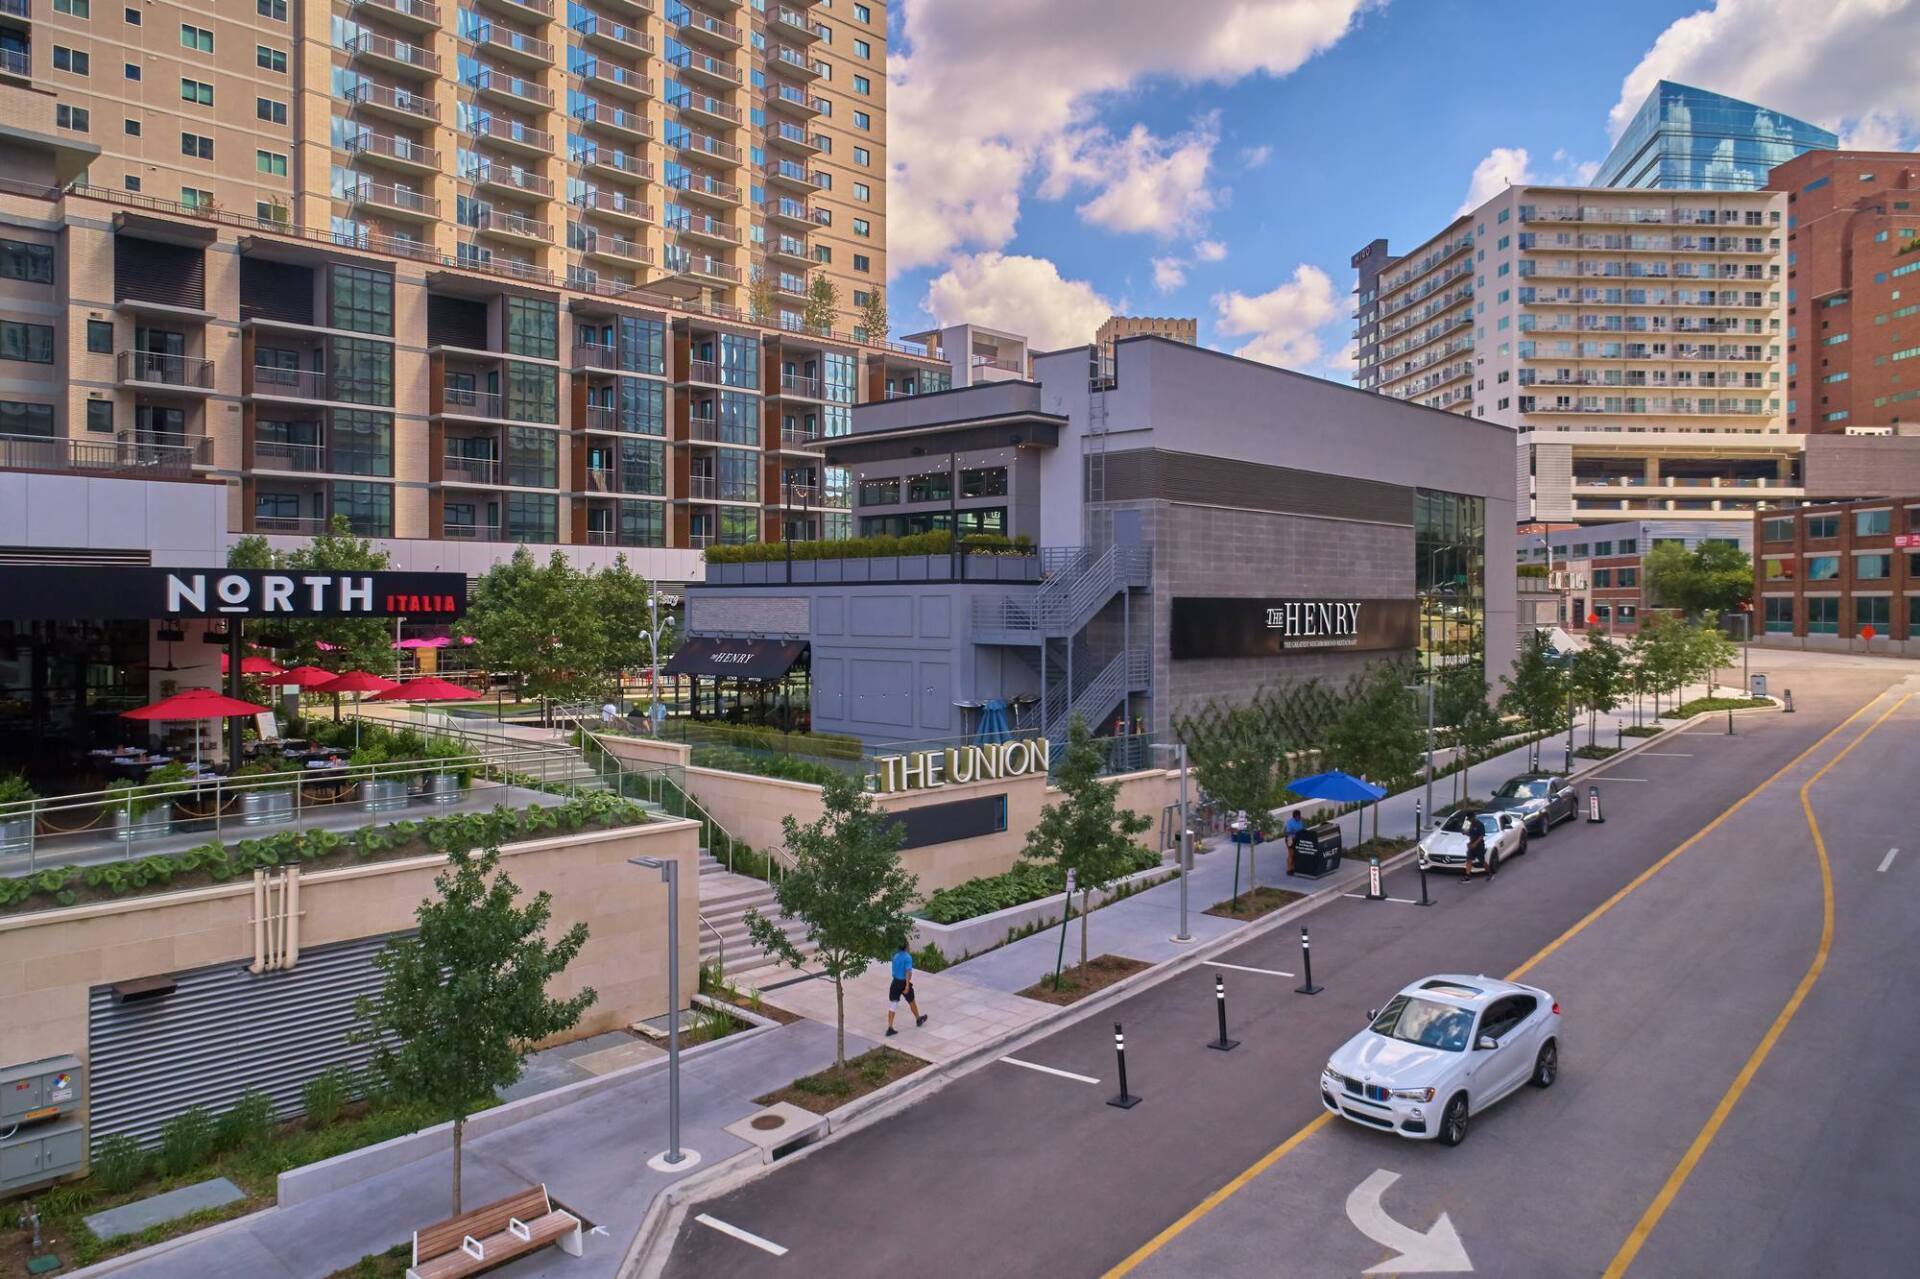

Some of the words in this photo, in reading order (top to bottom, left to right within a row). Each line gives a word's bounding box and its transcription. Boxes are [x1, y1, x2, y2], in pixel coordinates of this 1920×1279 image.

[166, 574, 373, 613] NORTH
[386, 594, 456, 612] ITALIA
[1266, 608, 1284, 625] THE
[1284, 602, 1361, 636] HENRY
[714, 652, 755, 663] HENRY
[878, 751, 945, 793] THE
[950, 739, 1049, 784] UNION
